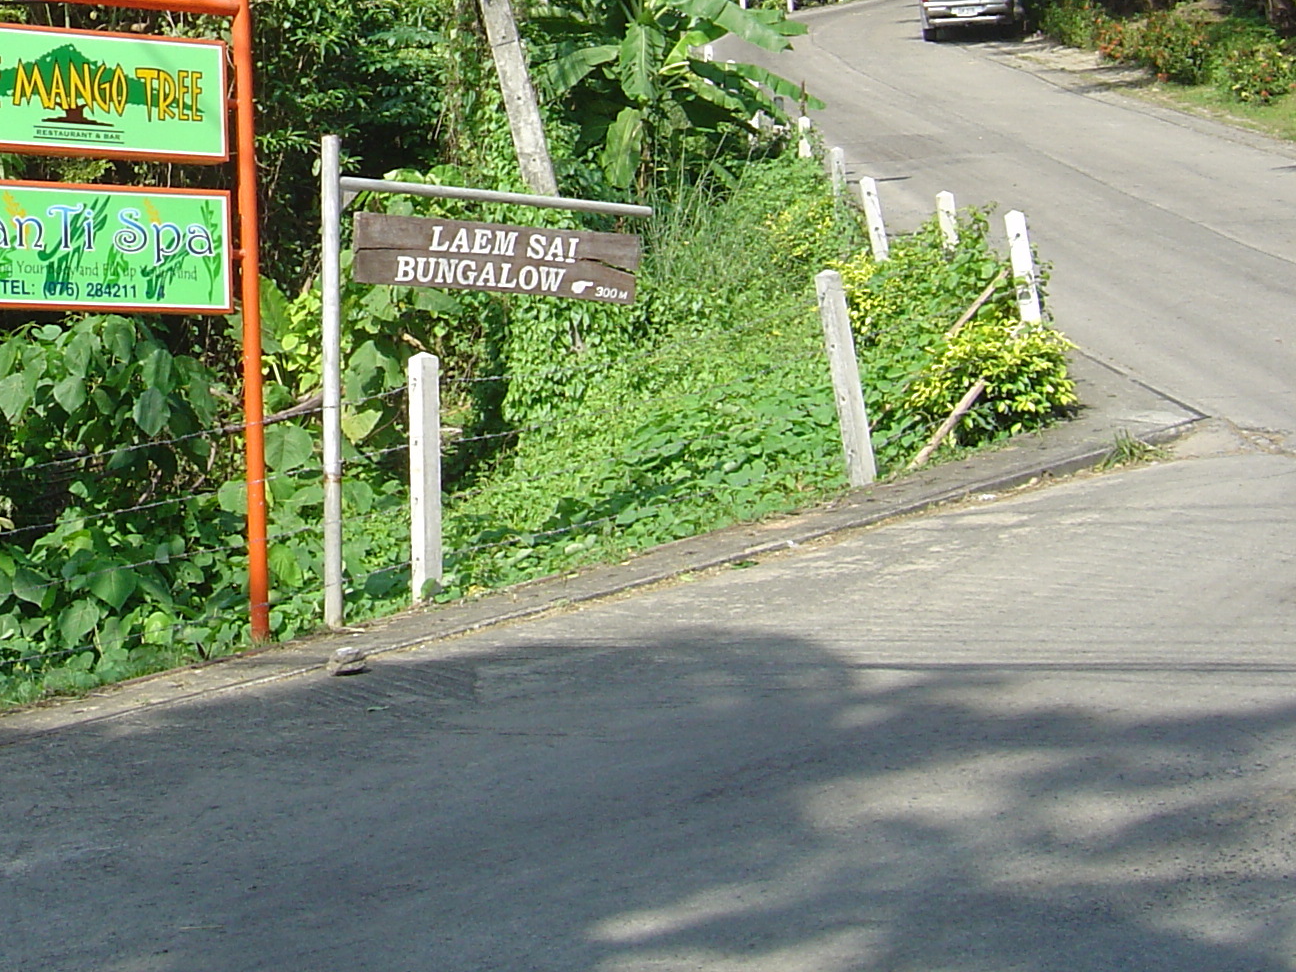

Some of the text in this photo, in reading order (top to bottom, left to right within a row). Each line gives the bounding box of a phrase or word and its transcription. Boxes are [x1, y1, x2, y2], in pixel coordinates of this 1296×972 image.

[12, 56, 128, 117] MANGO
[135, 66, 205, 122] TREE
[36, 129, 92, 139] RESTAURANT
[114, 206, 215, 266] Spa
[429, 225, 580, 264] LAEM SAI
[0, 279, 35, 295] TEL:
[43, 281, 80, 300] (076)
[394, 255, 567, 293] BUNGALOW
